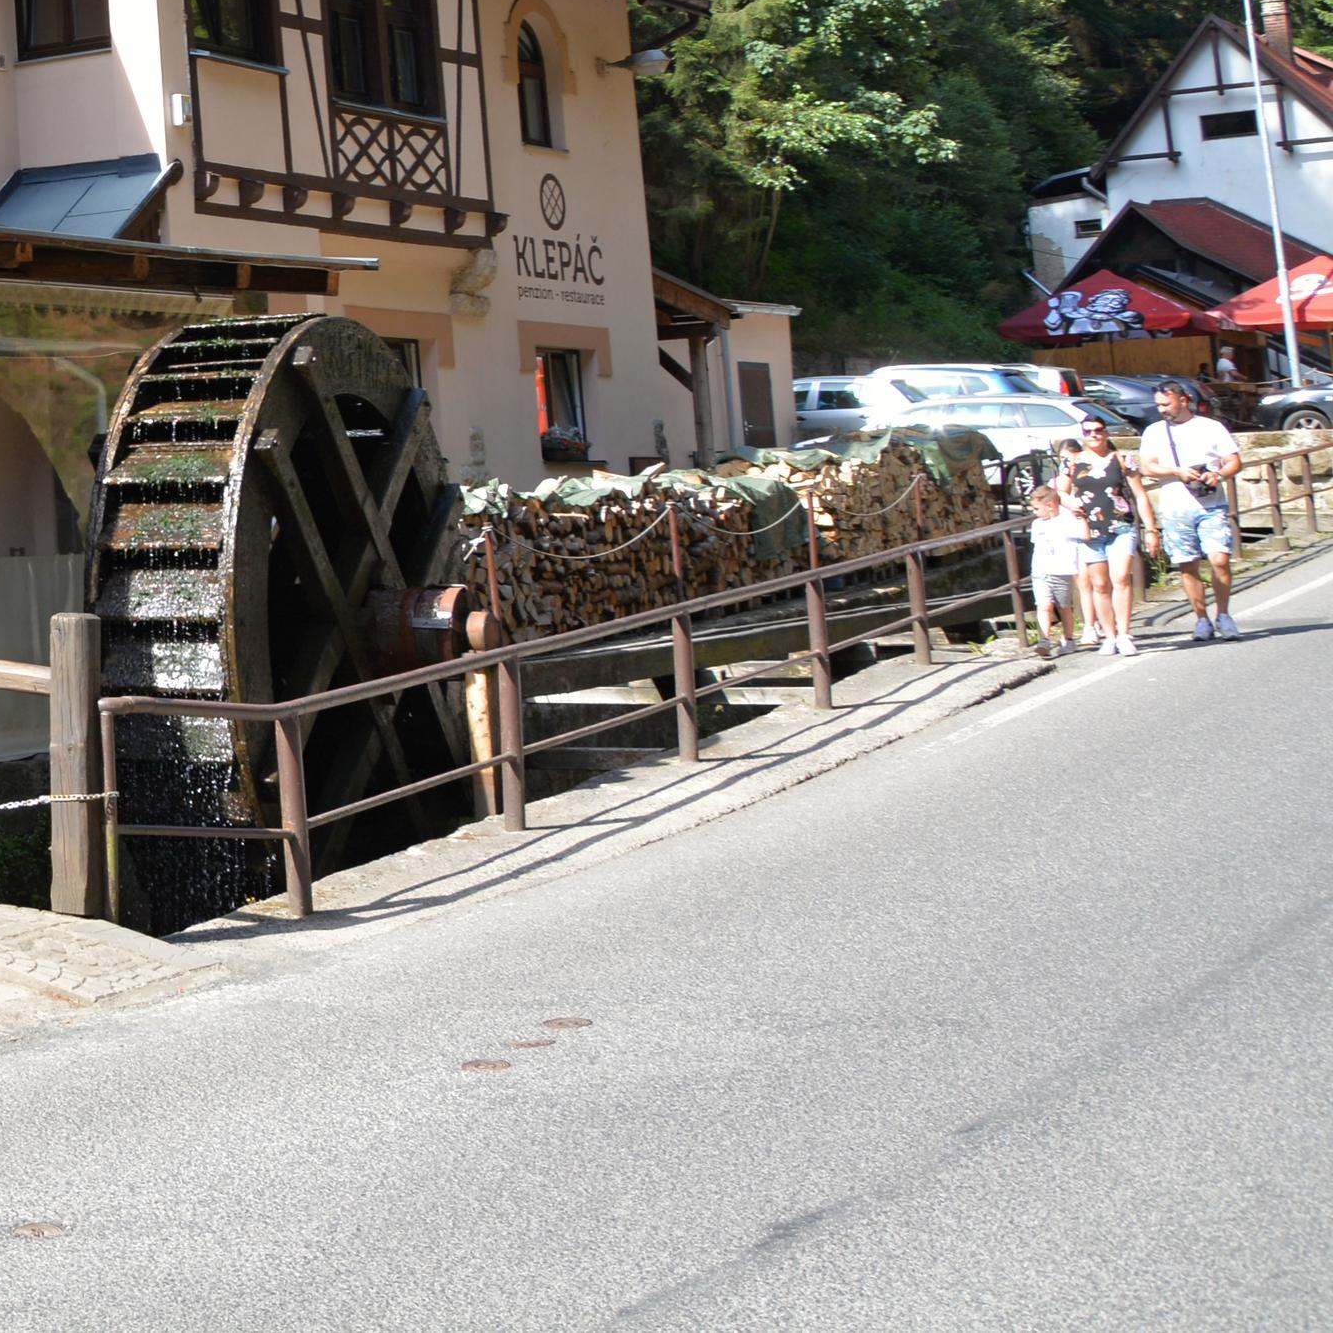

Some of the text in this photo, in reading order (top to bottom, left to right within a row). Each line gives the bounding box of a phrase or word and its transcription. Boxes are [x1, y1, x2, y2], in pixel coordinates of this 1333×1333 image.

[513, 233, 605, 286] KLEPÁČ
[517, 284, 554, 301] penzion
[561, 288, 605, 306] restaurace
